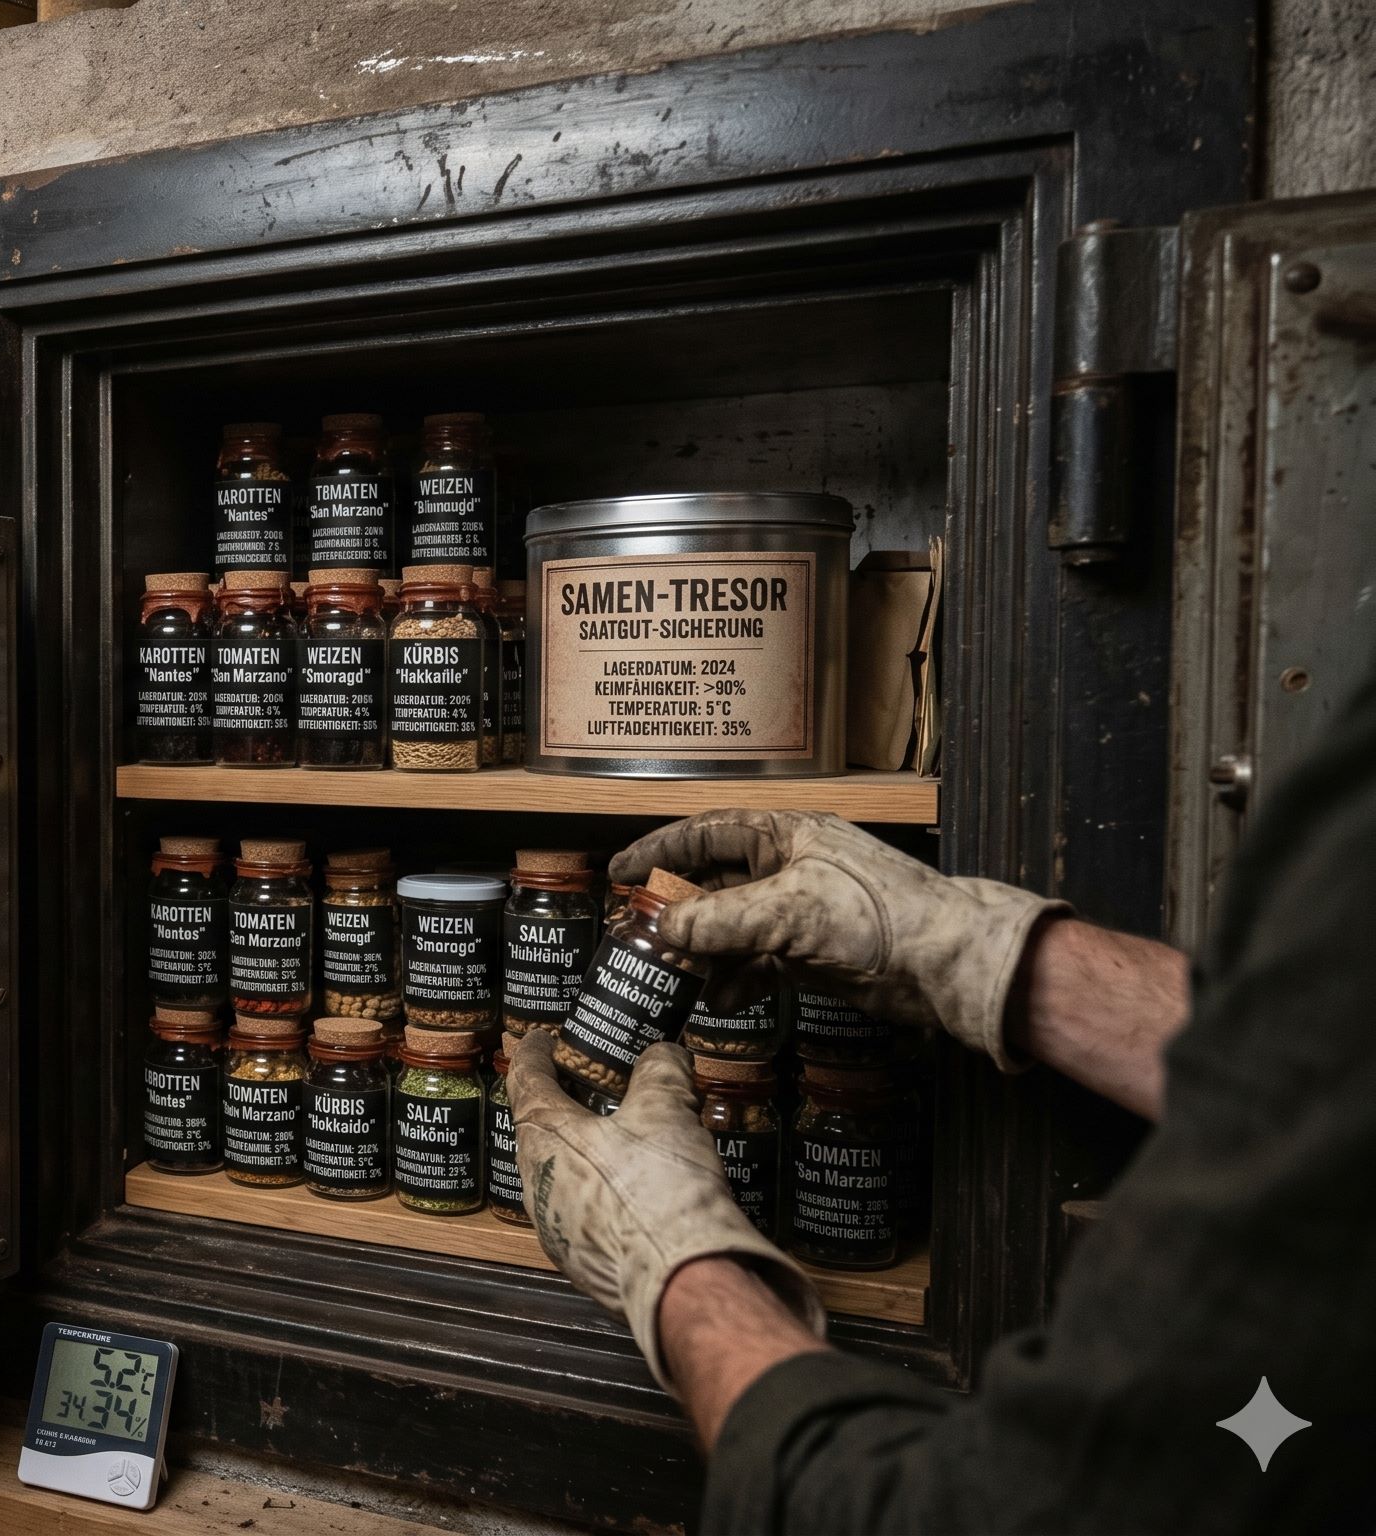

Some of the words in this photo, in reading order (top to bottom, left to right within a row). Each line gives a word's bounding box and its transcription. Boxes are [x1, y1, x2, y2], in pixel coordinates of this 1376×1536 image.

[217, 488, 281, 505] KAROTTEN
[561, 578, 788, 616] SAMEN-TRESOR
[579, 618, 764, 640] SAATGUT-SICHERUNG
[139, 648, 205, 664] KAROTTEN
[217, 648, 280, 664] TOMATEN
[307, 647, 362, 665] WEIZEN
[403, 643, 459, 665] KÜRBIS
[604, 660, 697, 676] LAGERDATUM:
[701, 660, 736, 675] 2024
[703, 680, 746, 696] >90%
[609, 701, 702, 716] TEMPERATUR:
[722, 720, 751, 736] 35%
[151, 903, 211, 922] KAROTTEN
[234, 911, 295, 930] TOMATEN
[327, 912, 369, 928] WEIZEN
[418, 916, 474, 934] WEIZEN
[519, 924, 566, 944] SALAT
[227, 1083, 288, 1104] TOMATEN
[315, 1093, 365, 1116] KÜRBIS
[407, 1102, 451, 1124] SALAT
[308, 1113, 375, 1134] "Hokkaido"
[803, 1141, 881, 1168] TOMATEN
